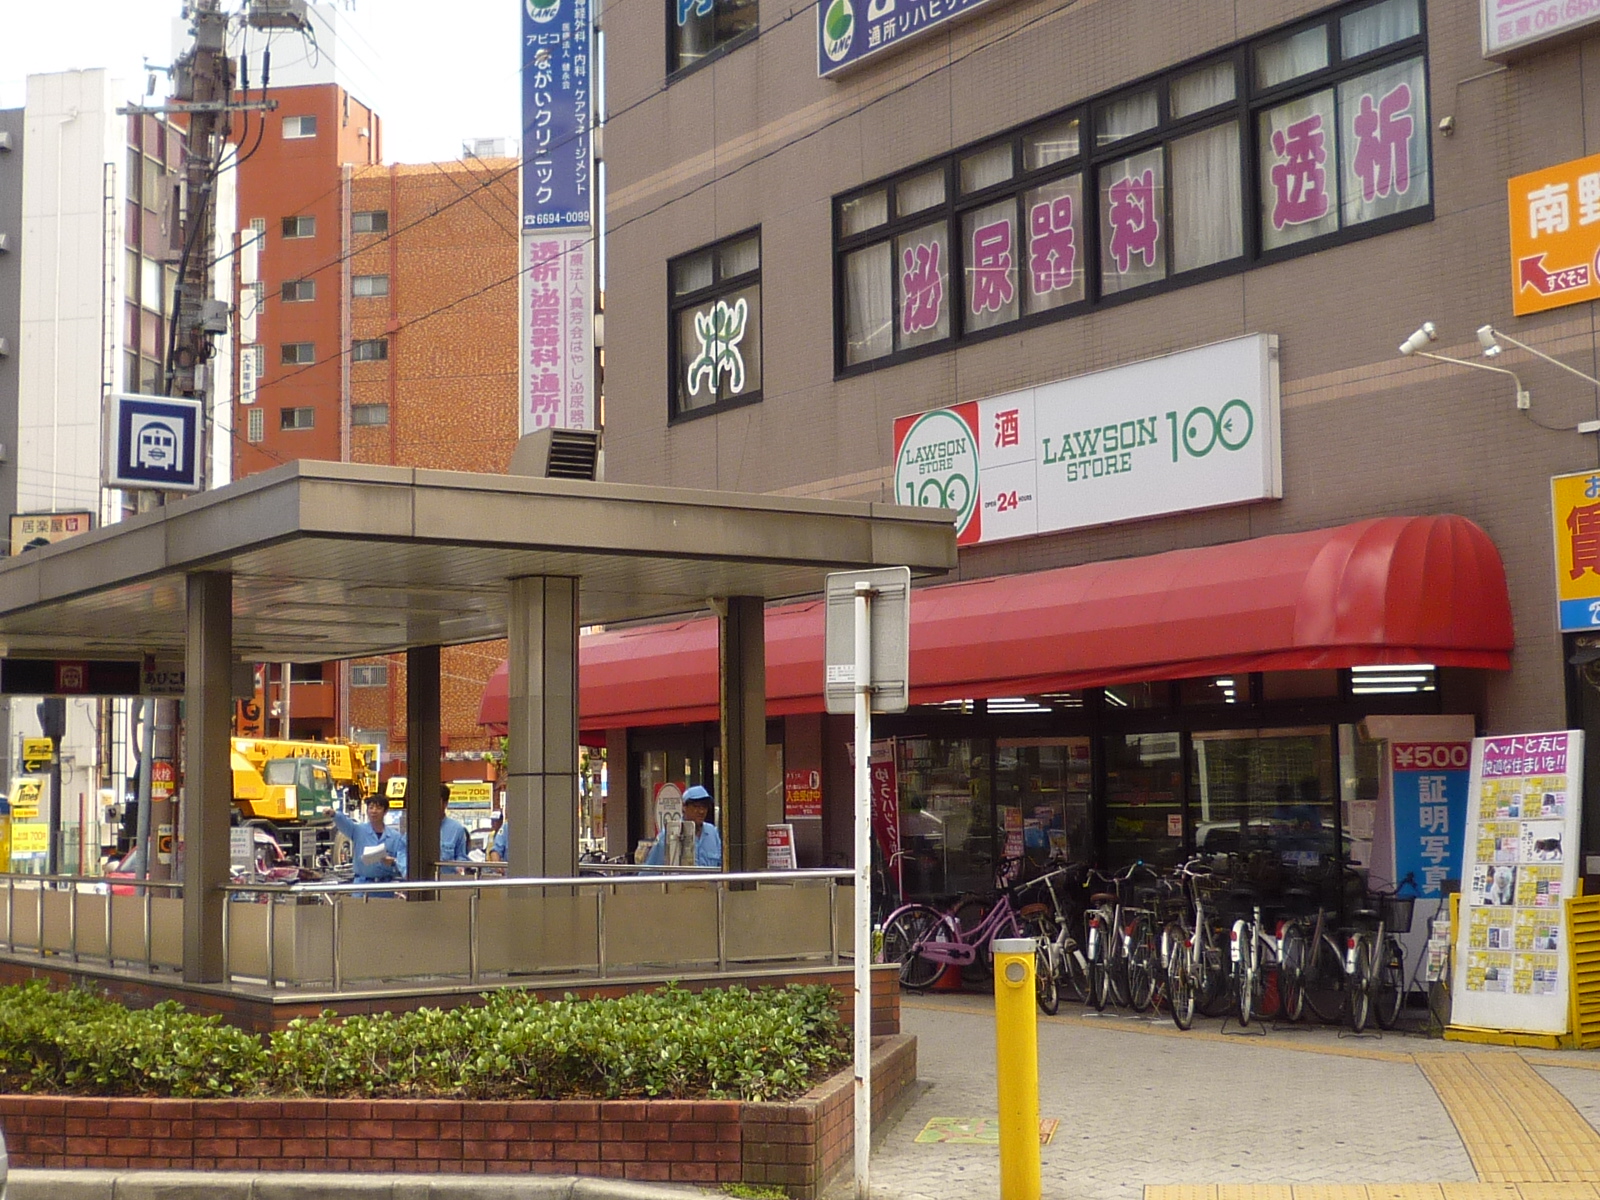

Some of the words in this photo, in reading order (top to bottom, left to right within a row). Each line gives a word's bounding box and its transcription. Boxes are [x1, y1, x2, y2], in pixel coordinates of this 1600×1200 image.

[526, 33, 560, 46] アビコ
[534, 48, 552, 204] ながいクリニック
[1270, 82, 1413, 231] 透析
[536, 211, 589, 225] 6694-0099
[901, 168, 1159, 335] 泌尿器科
[1546, 268, 1586, 291] すぐそこ
[570, 239, 584, 430] 医療法人真芳会はやし泌尿器
[994, 409, 1020, 448] 酒
[1042, 416, 1158, 466] LAWSON
[1165, 398, 1254, 463] 100
[905, 437, 967, 466] LAWSON
[918, 457, 954, 475] STORE
[1067, 452, 1132, 482] STORE
[997, 490, 1018, 512] 24
[143, 671, 186, 685] あびこ
[1396, 745, 1468, 768] ¥500
[19, 785, 41, 802] Times
[1419, 775, 1450, 895] 証明写真
